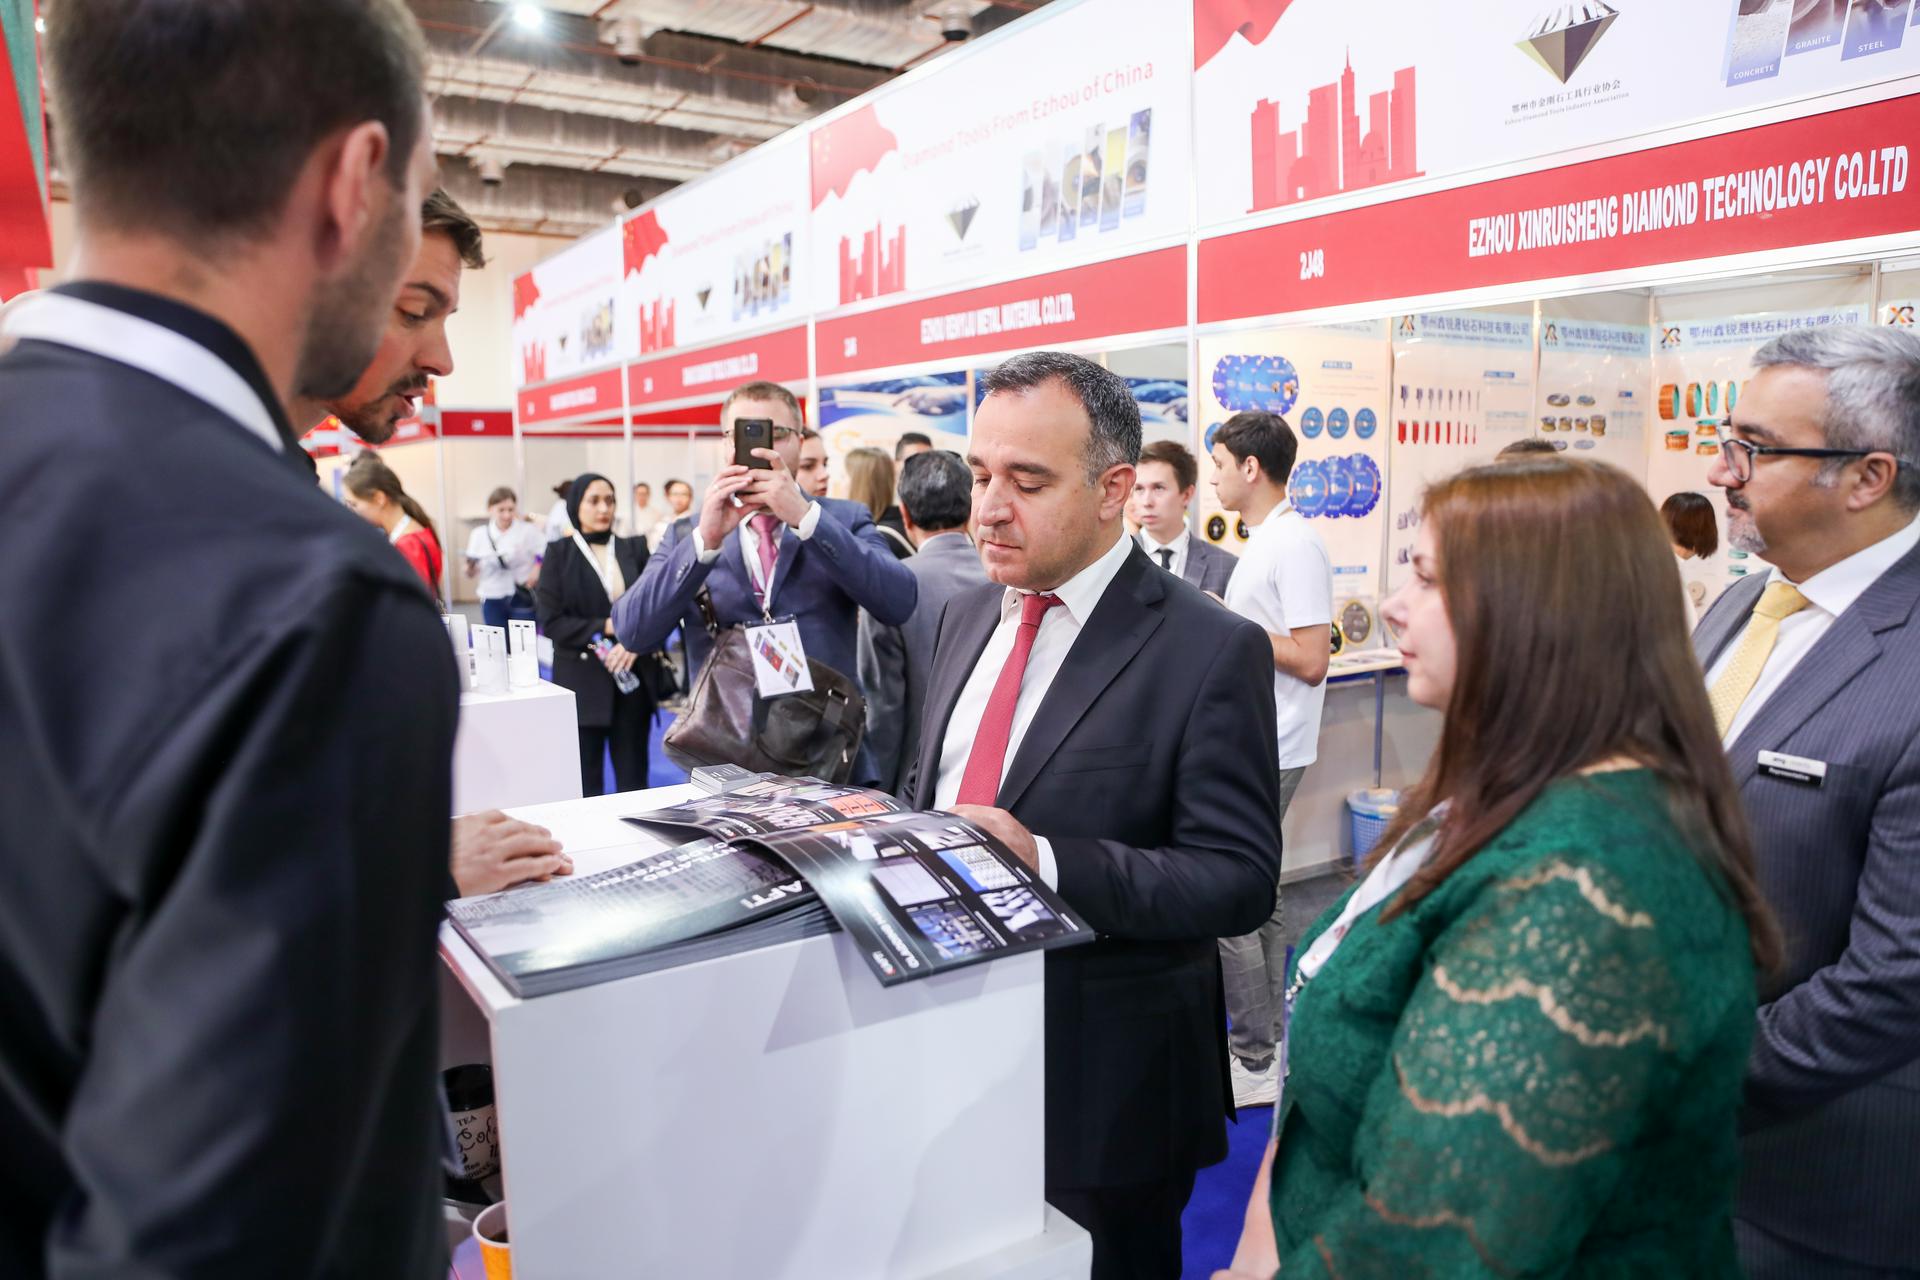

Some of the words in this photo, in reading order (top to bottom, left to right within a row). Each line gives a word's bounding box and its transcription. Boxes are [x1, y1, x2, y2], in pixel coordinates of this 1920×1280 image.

[1795, 35, 1831, 50] GRANITE
[1858, 40, 1885, 53] STEEL
[1734, 64, 1774, 80] CONCRETE
[1033, 93, 1079, 121] Ezhou
[1083, 76, 1100, 102] of
[1103, 62, 1153, 93] China
[1469, 213, 1515, 257] EZHOU
[1517, 195, 1618, 251] XINRUISHENG
[1622, 181, 1698, 235] DIAMOND
[1703, 157, 1830, 222] TECHNOLOGY
[1834, 145, 1909, 200] CO.LTD
